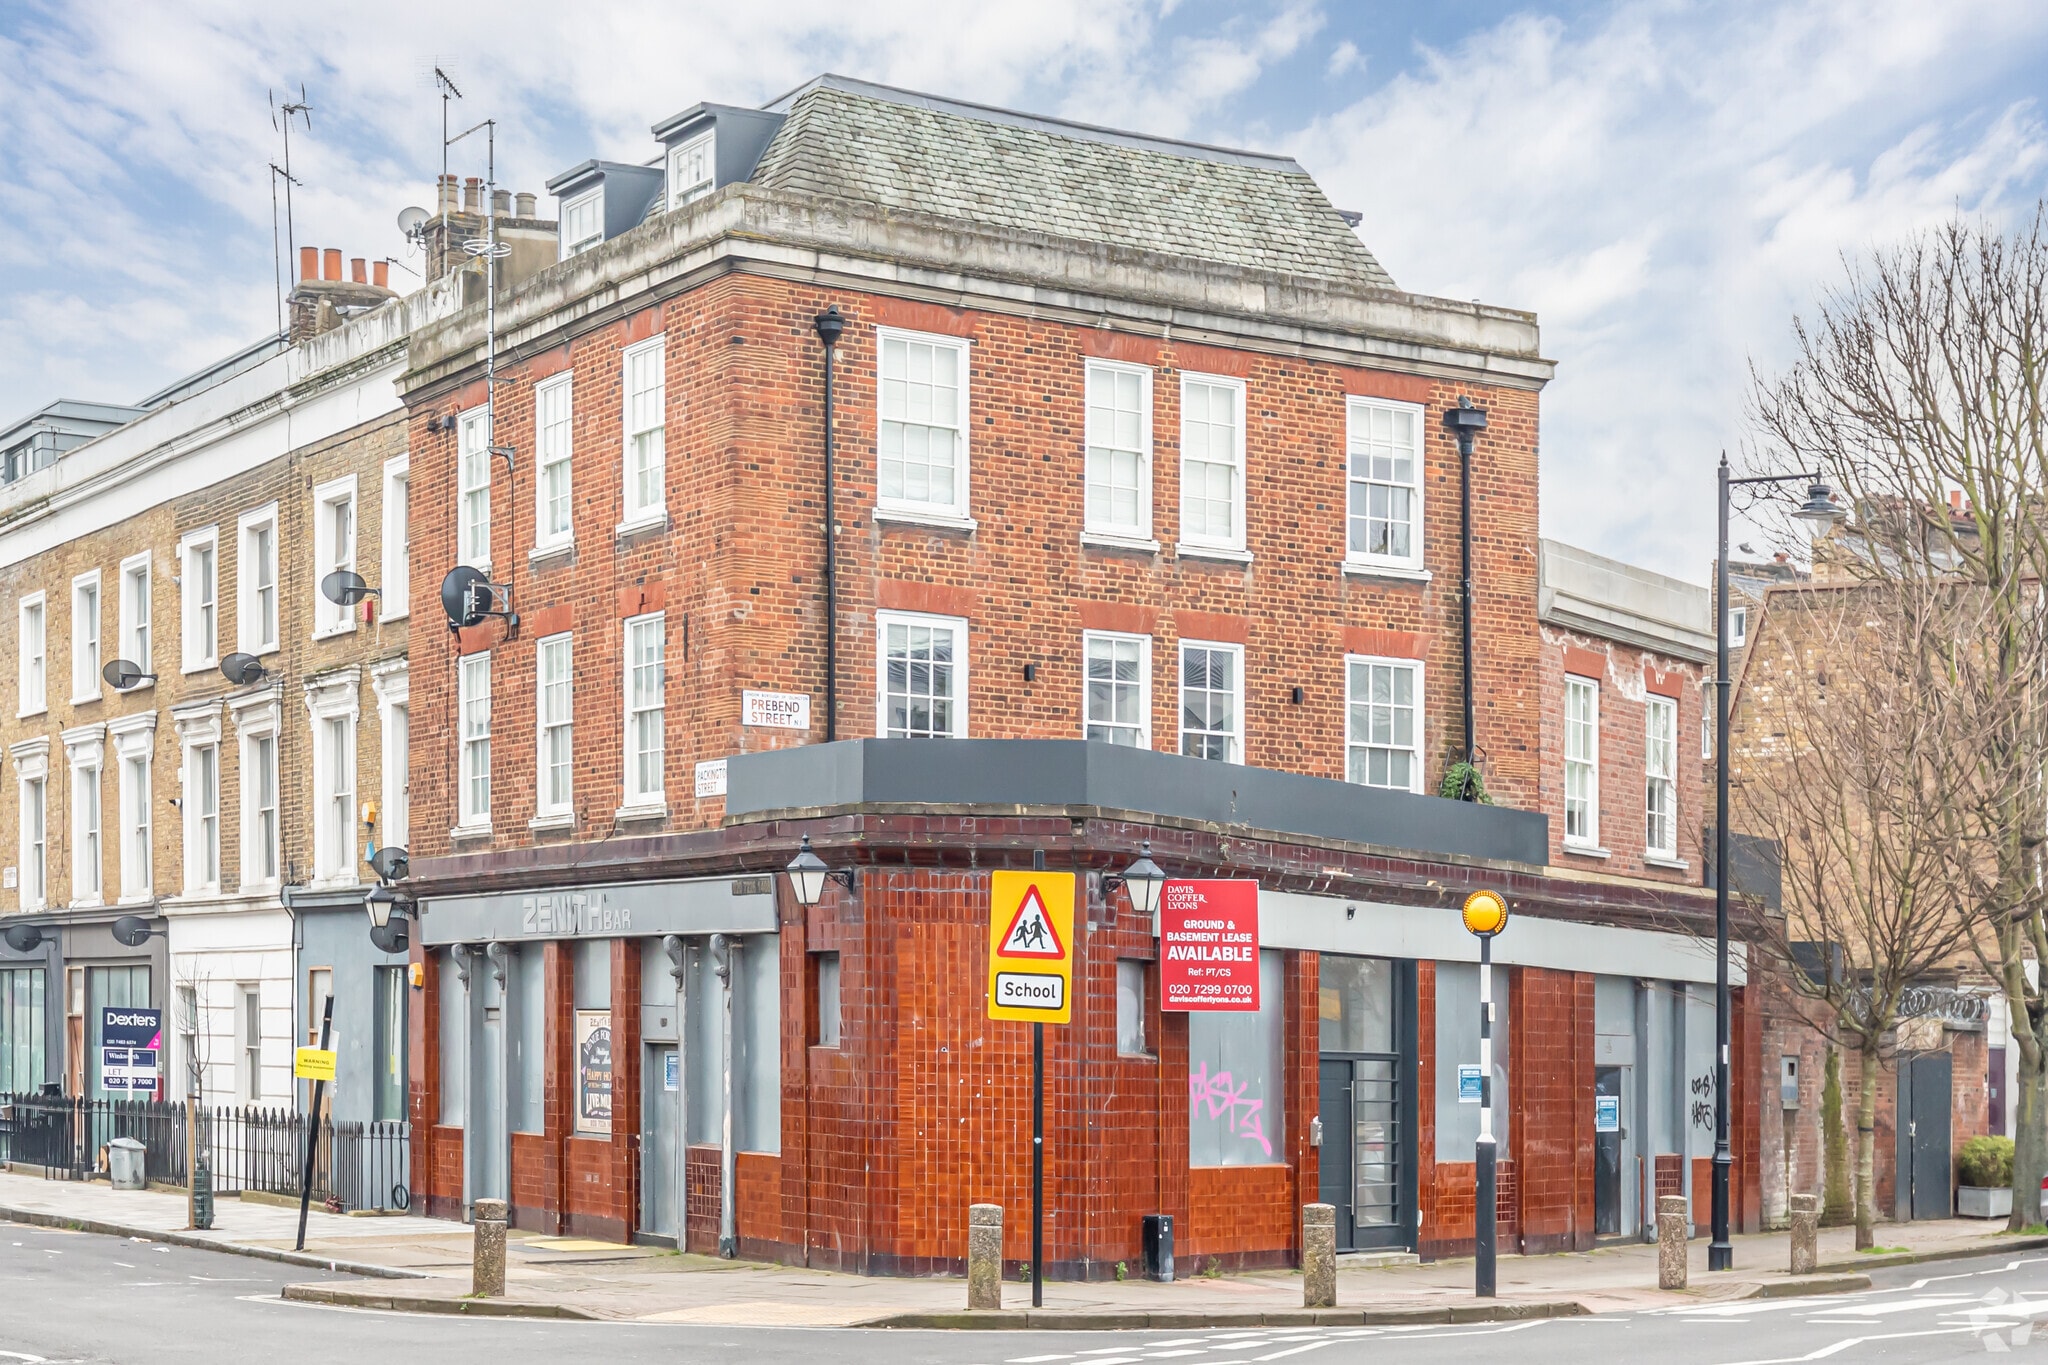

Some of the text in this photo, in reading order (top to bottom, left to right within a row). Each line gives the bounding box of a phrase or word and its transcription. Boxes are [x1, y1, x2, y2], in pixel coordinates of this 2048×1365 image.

[751, 698, 800, 713] PREBEND
[751, 711, 793, 725] STREET
[697, 768, 727, 781] PACKINGTO
[697, 781, 717, 795] STREET
[1167, 885, 1194, 894] DAVIS
[1167, 893, 1208, 904] COFFER
[1167, 902, 1198, 910] LYONS
[522, 893, 631, 934] ZENITH BAR
[1183, 919, 1235, 930] GROUND &
[1166, 932, 1253, 943] BASEMENT LEASE
[1167, 945, 1253, 962] AVAILABLE
[1187, 967, 1232, 978] Ref: PT/CS
[1004, 981, 1056, 999] School
[1169, 984, 1253, 995] 020 7299 0700
[1169, 995, 1253, 1005] daviscofferlyons.co.uk
[106, 1012, 157, 1027] Dexters
[108, 1052, 140, 1060] Winkwth
[108, 1068, 121, 1076] LET
[586, 1093, 600, 1114] LIVE
